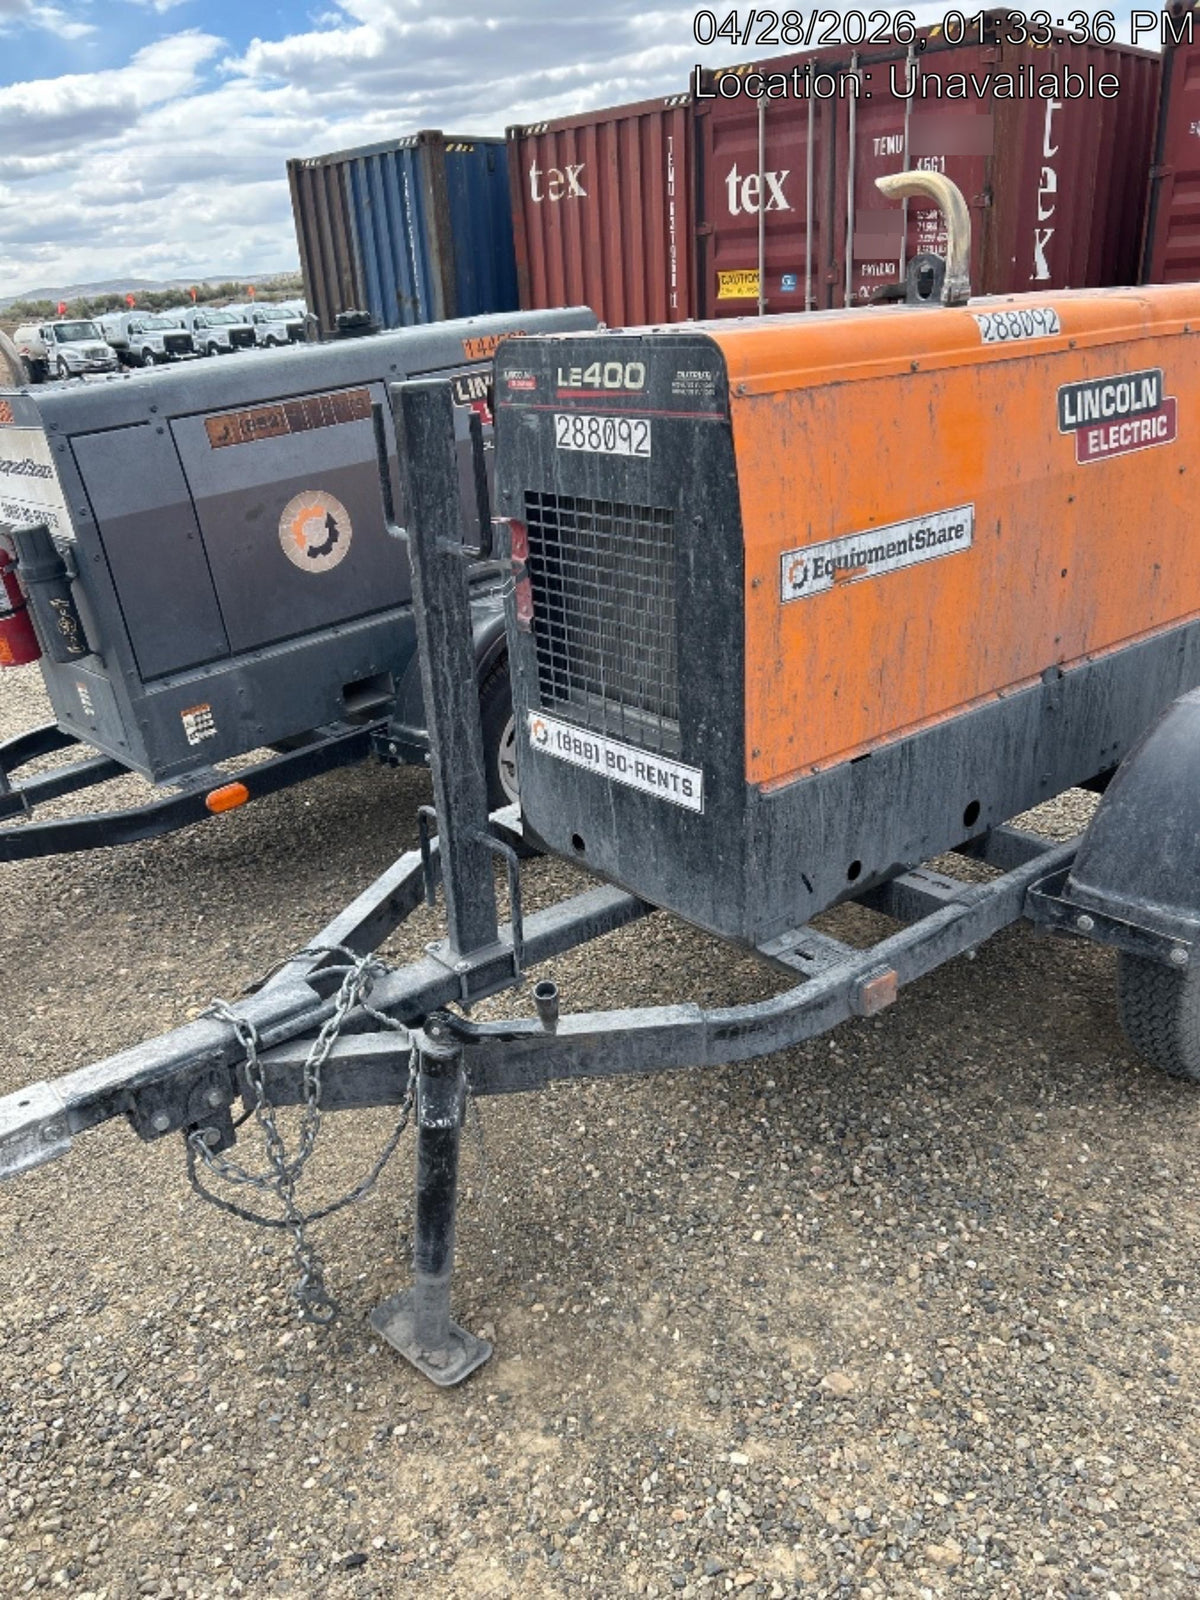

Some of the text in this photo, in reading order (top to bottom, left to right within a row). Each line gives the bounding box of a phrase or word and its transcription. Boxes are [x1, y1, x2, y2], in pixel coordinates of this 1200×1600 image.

[529, 159, 588, 204] tex
[725, 162, 791, 216] tex
[978, 308, 1059, 341] 288092
[557, 362, 646, 389] LE400
[1063, 376, 1158, 426] LINCOLN
[557, 415, 650, 454] 288092
[1088, 415, 1168, 455] ELECTRIC
